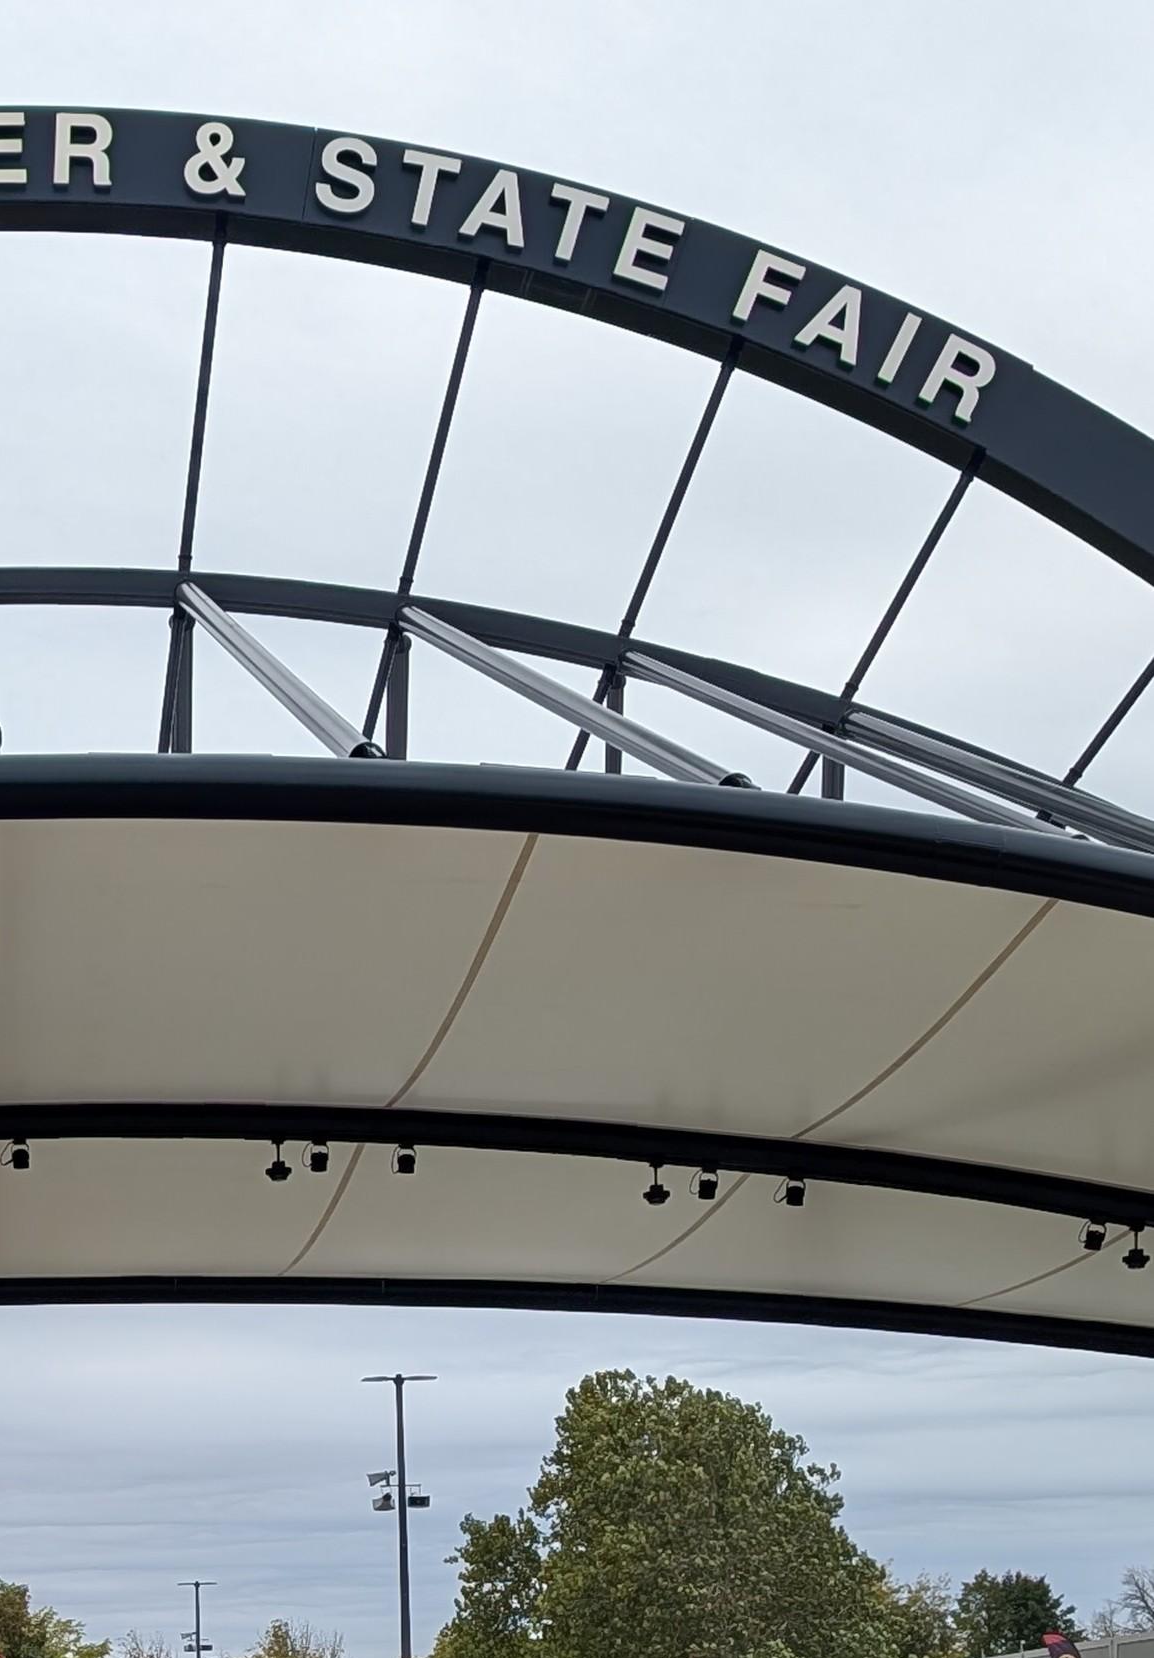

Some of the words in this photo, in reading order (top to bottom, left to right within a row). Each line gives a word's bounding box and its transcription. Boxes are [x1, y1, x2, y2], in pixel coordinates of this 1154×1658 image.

[183, 121, 246, 197] &
[314, 137, 686, 292] STATE
[730, 249, 997, 425] FAIR
